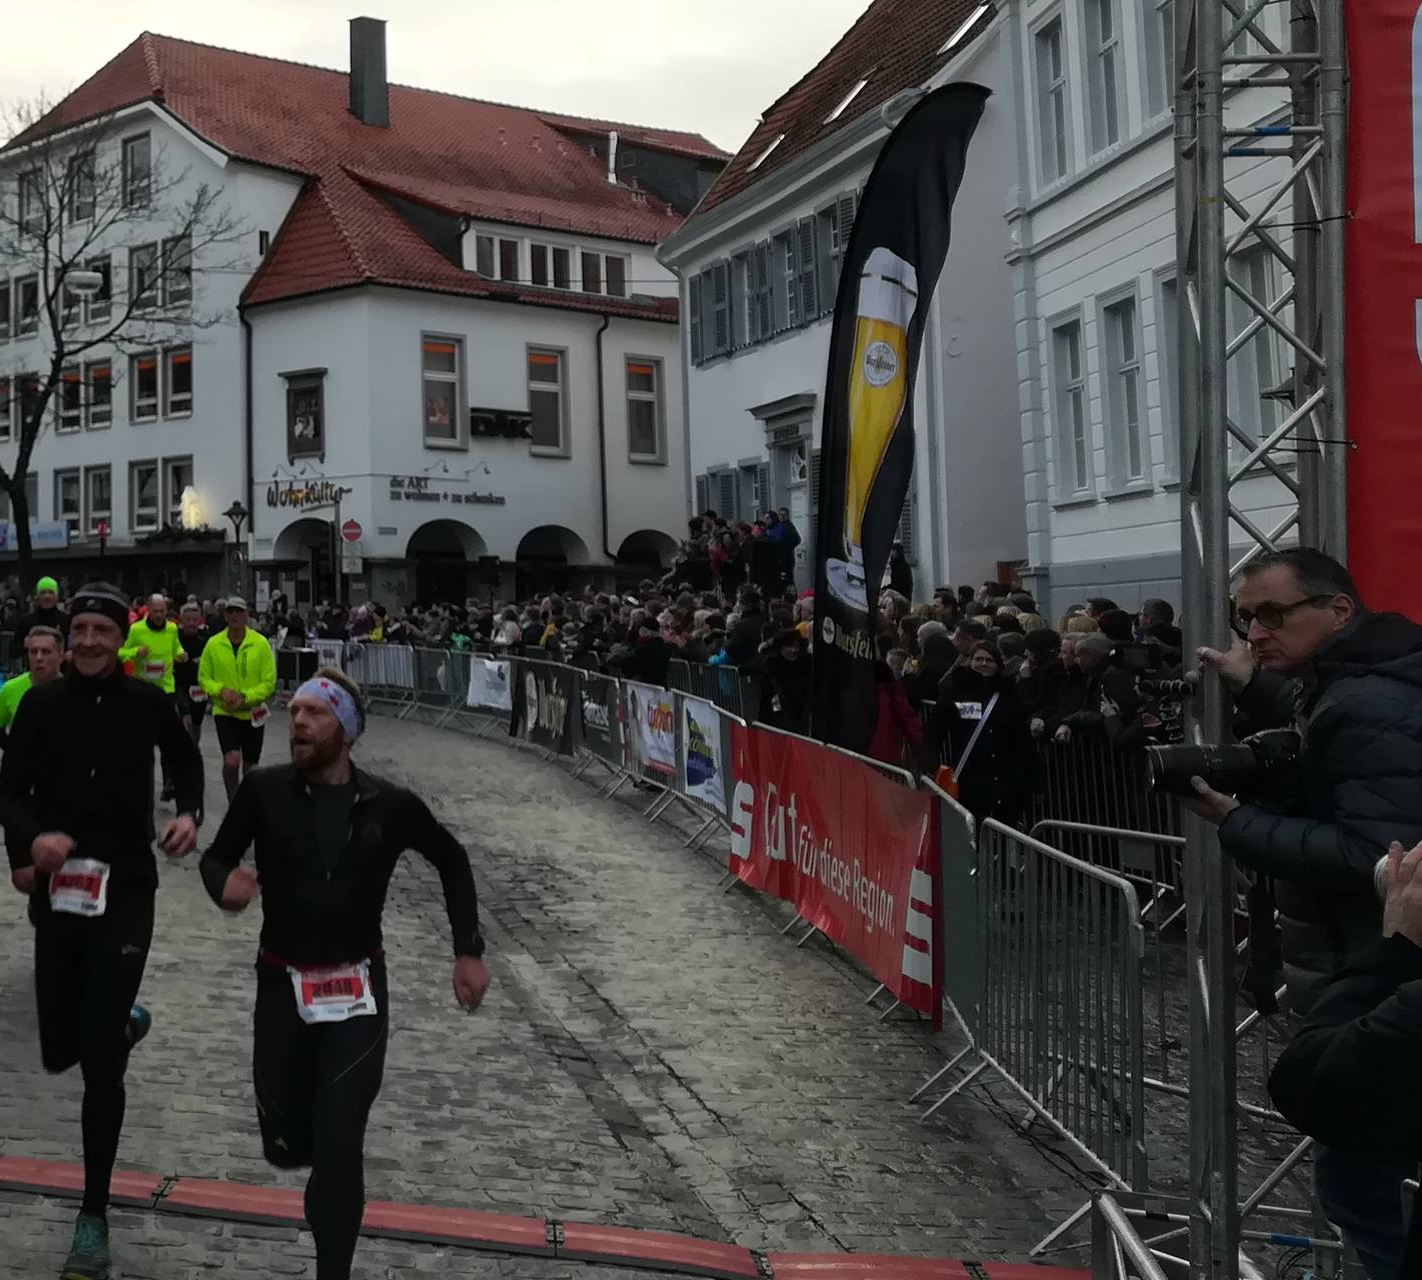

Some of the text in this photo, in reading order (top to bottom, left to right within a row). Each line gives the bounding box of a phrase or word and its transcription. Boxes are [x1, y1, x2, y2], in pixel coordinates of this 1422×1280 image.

[407, 476, 430, 489] ART
[819, 837, 852, 903] diese
[852, 857, 896, 938] Region.
